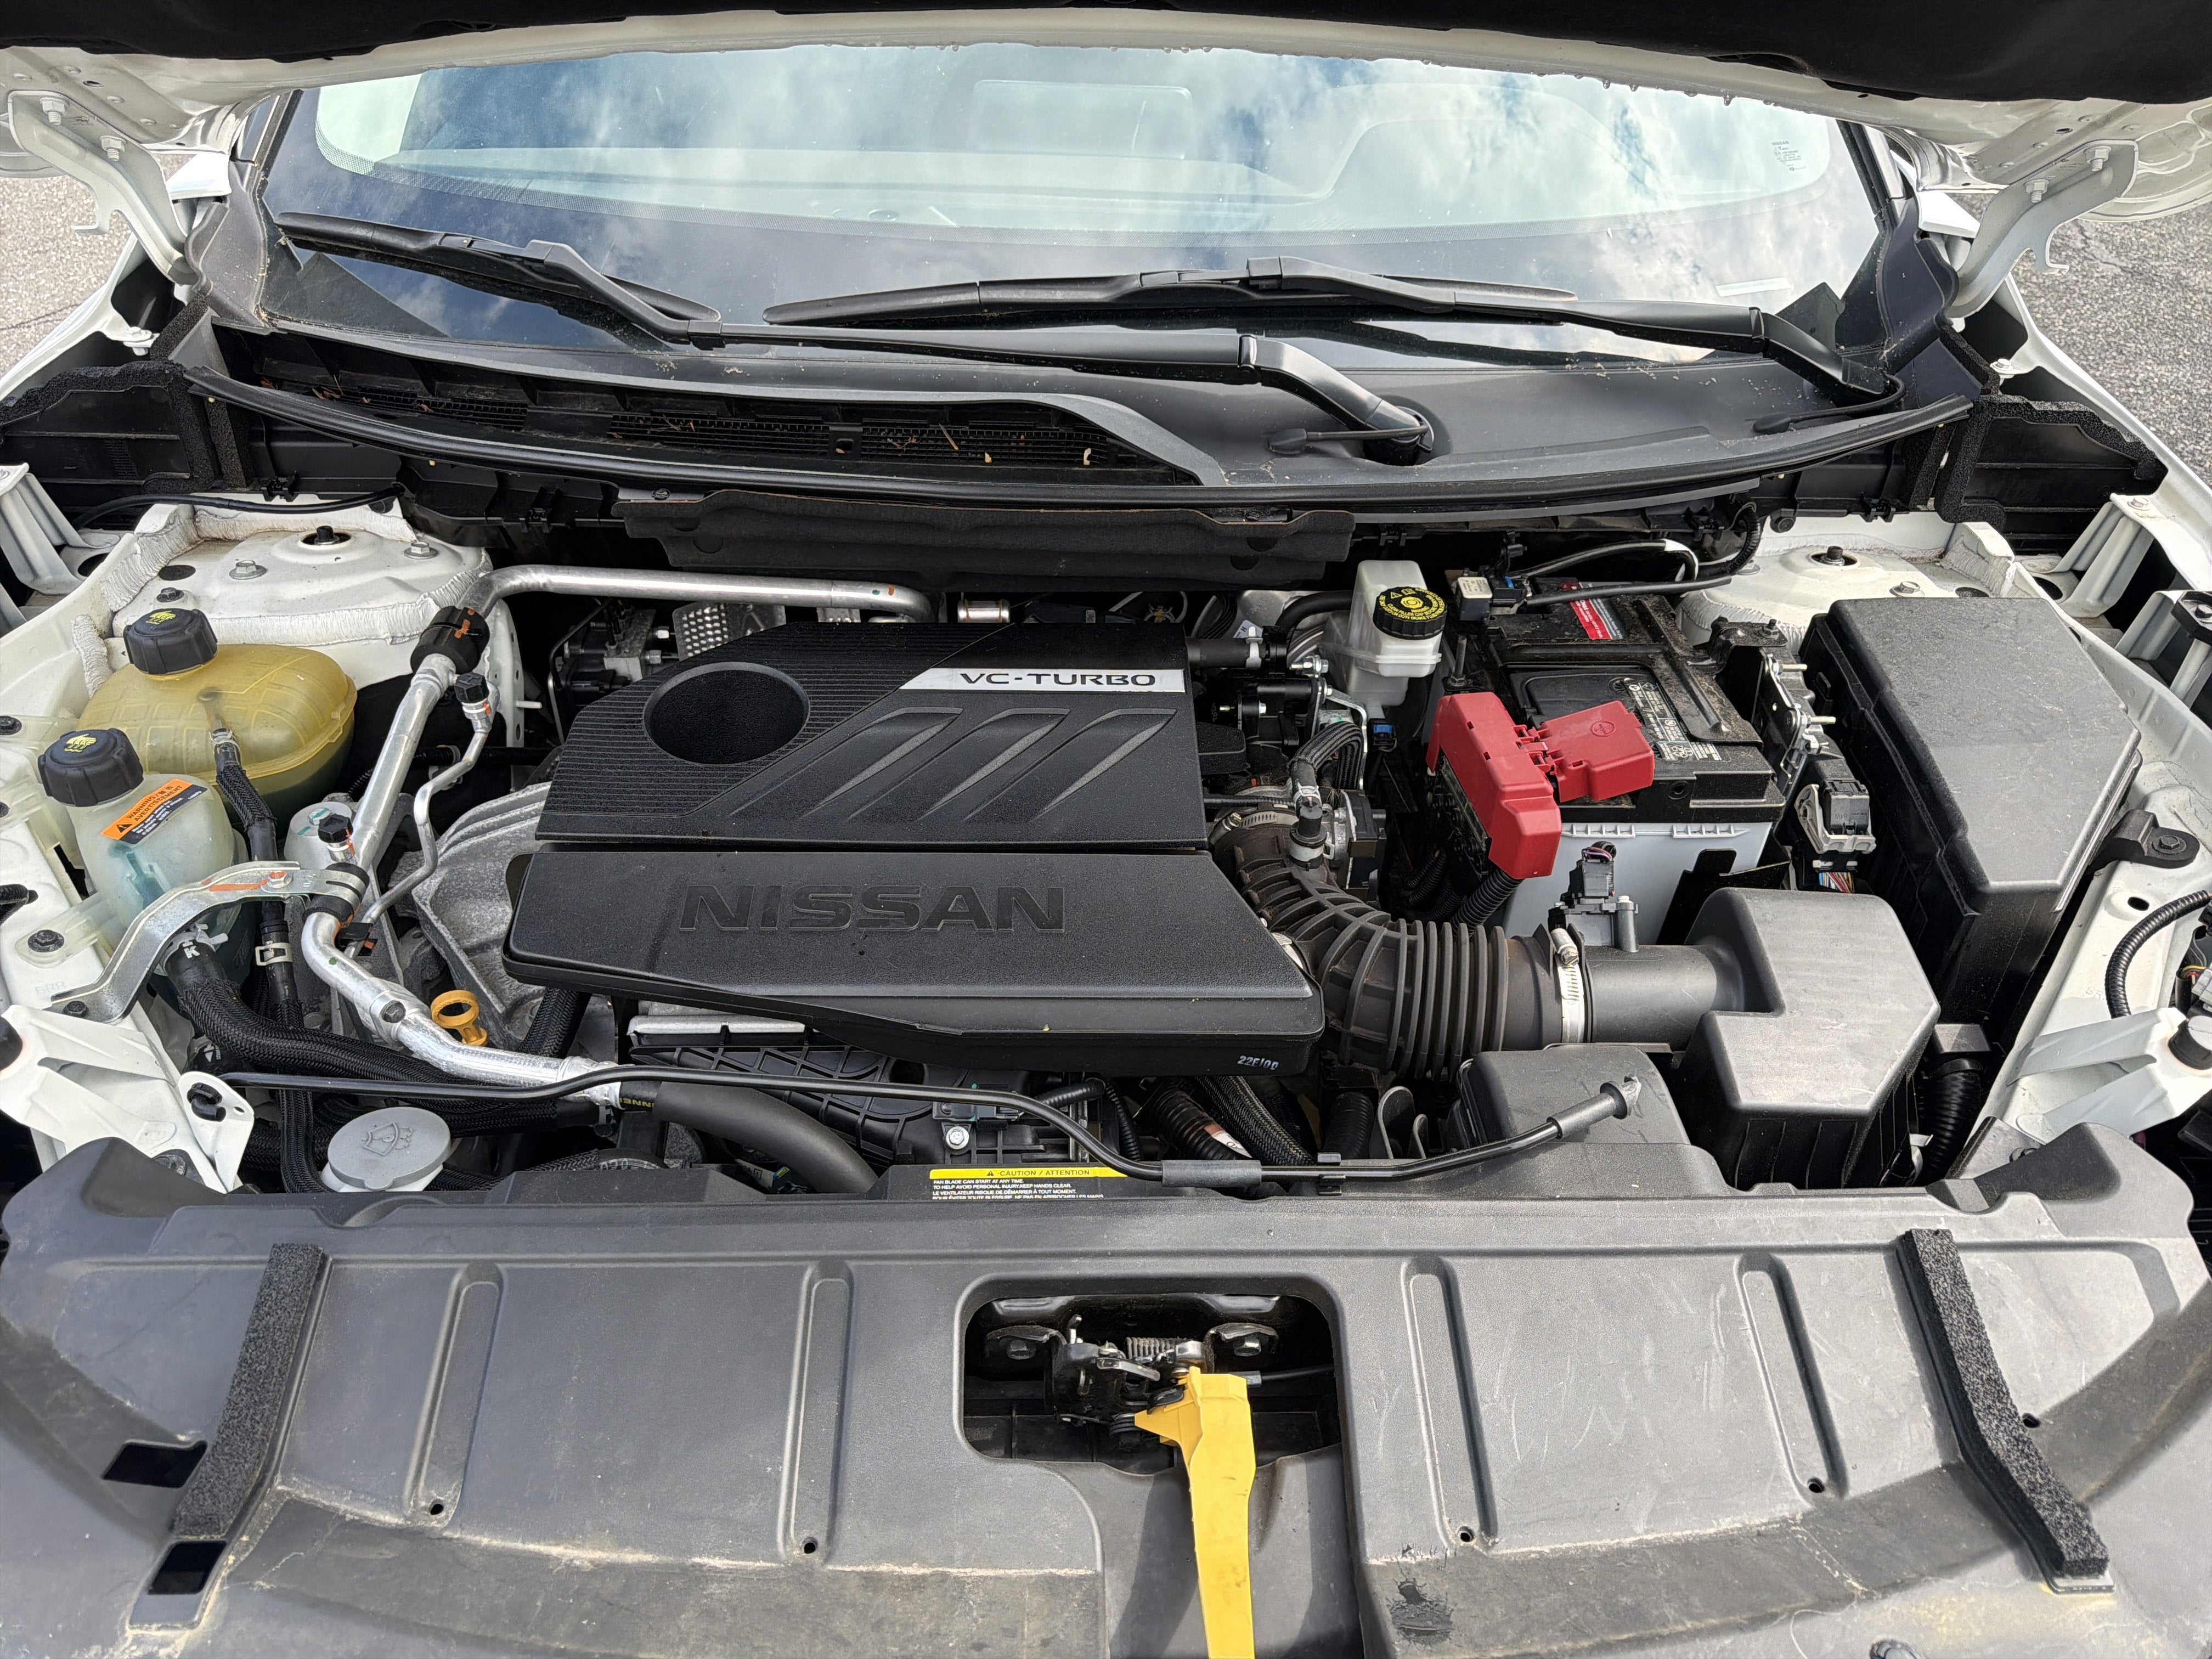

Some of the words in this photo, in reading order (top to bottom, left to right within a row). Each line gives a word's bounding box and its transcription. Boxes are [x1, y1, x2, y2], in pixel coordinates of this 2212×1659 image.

[960, 673, 1156, 686] VC-TURBO
[134, 785, 183, 822] AVERTISSEMENT
[679, 884, 1065, 932] NISSAN
